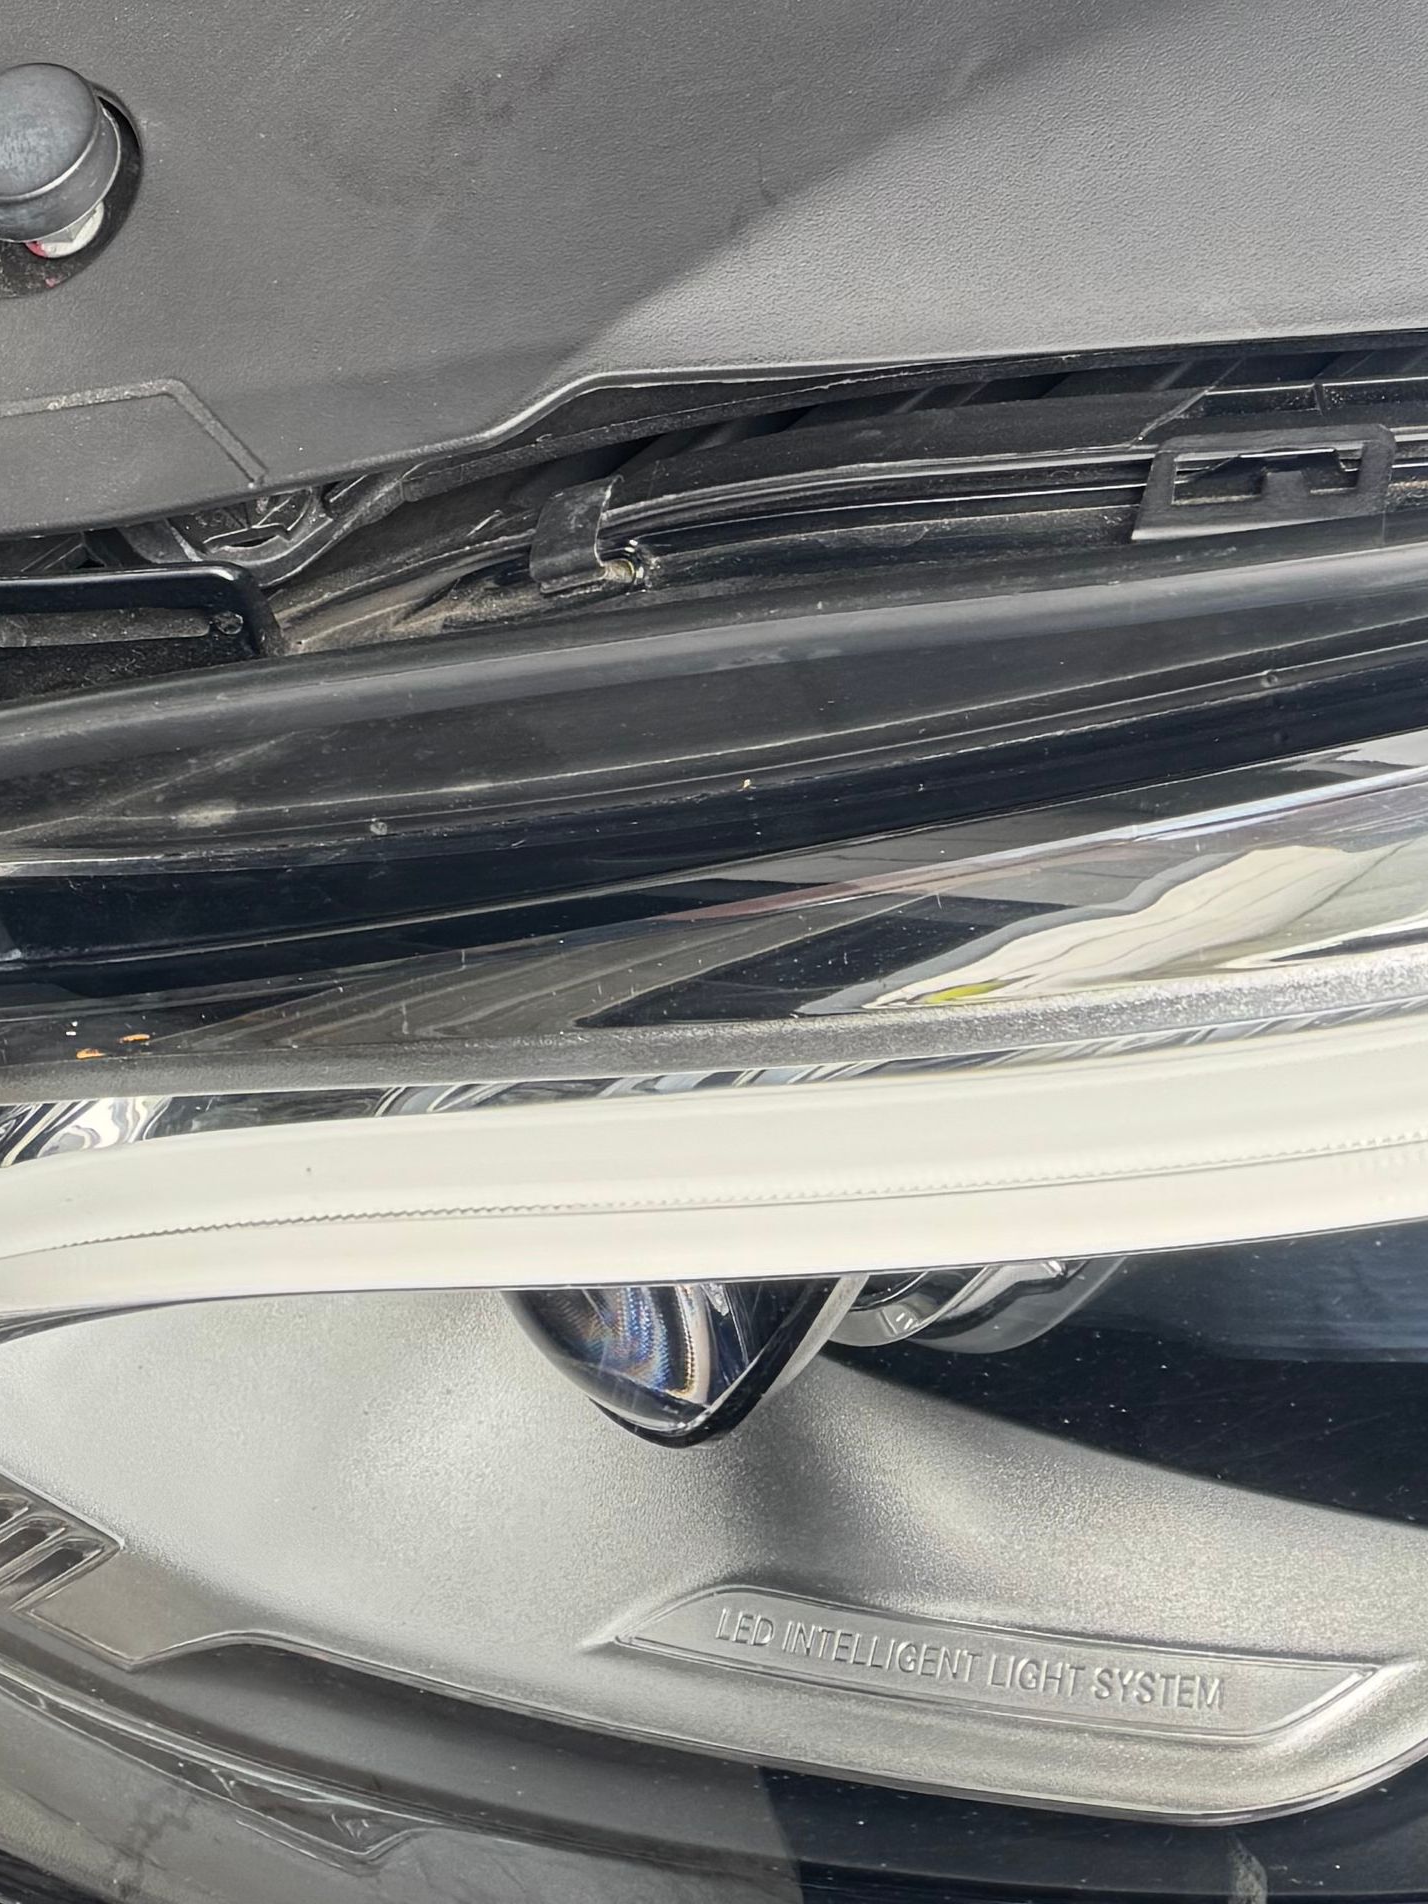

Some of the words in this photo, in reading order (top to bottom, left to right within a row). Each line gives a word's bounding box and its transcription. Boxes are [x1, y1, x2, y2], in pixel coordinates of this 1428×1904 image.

[715, 1607, 775, 1647] LED
[782, 1619, 981, 1683] INTELLIGENT
[987, 1652, 1086, 1694] LIGHT
[1093, 1667, 1227, 1711] SYSTEM
